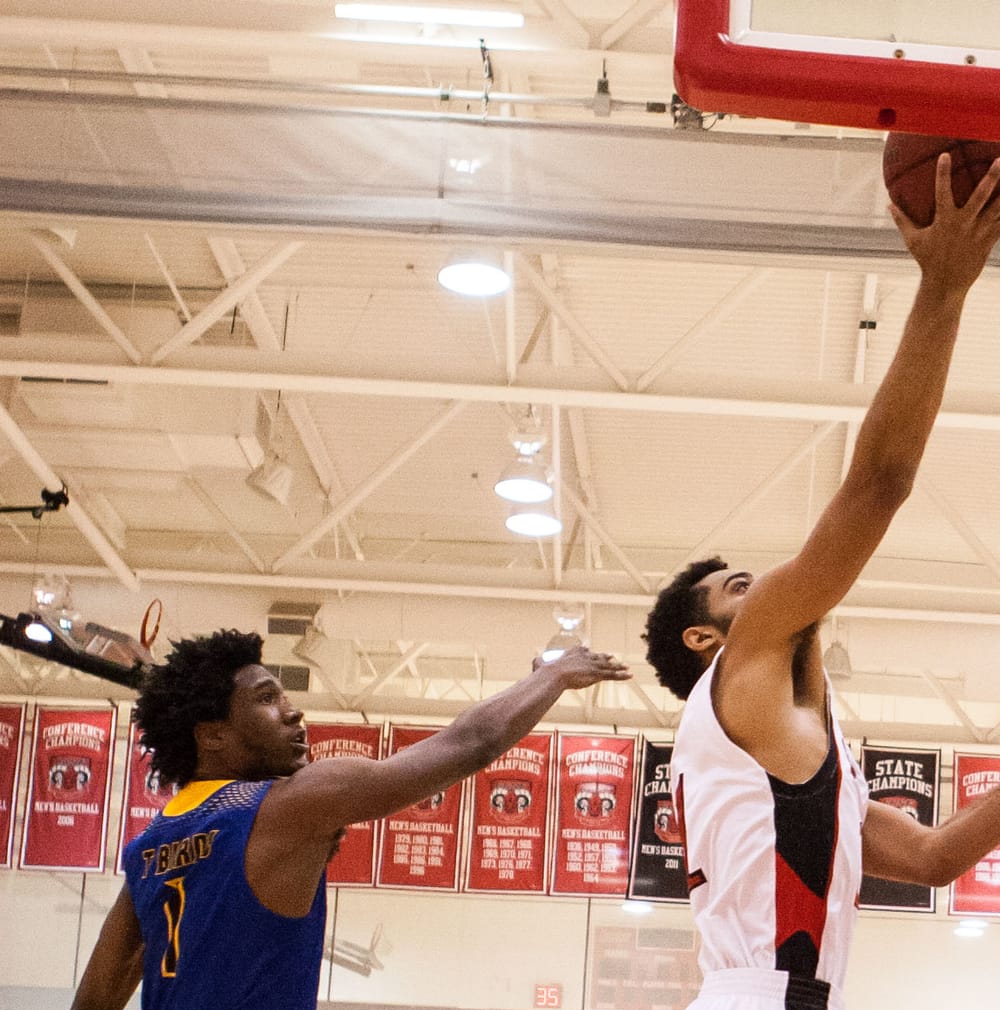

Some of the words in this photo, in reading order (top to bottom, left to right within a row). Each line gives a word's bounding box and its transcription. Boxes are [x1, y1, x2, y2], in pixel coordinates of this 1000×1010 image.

[43, 722, 106, 744] CONFERENCE
[45, 736, 101, 752] CHAMPIONS
[310, 739, 374, 758] CONFERENCE
[502, 747, 544, 766] ERENCE
[566, 750, 628, 769] CONFERENCE
[569, 761, 625, 779] CHAMPIONS
[875, 760, 923, 779] STATE
[56, 802, 100, 816] BASKETBALL
[389, 820, 409, 831] MEN'S
[409, 822, 454, 834] BASKETBALL
[477, 825, 497, 836] MEN'S
[497, 826, 541, 837] BASKETBALL
[562, 829, 582, 839] MEN'S
[582, 830, 626, 841] BASKETBALL
[641, 844, 660, 855] MEN'S
[661, 845, 684, 857] BASKE
[536, 987, 558, 1006] 35
